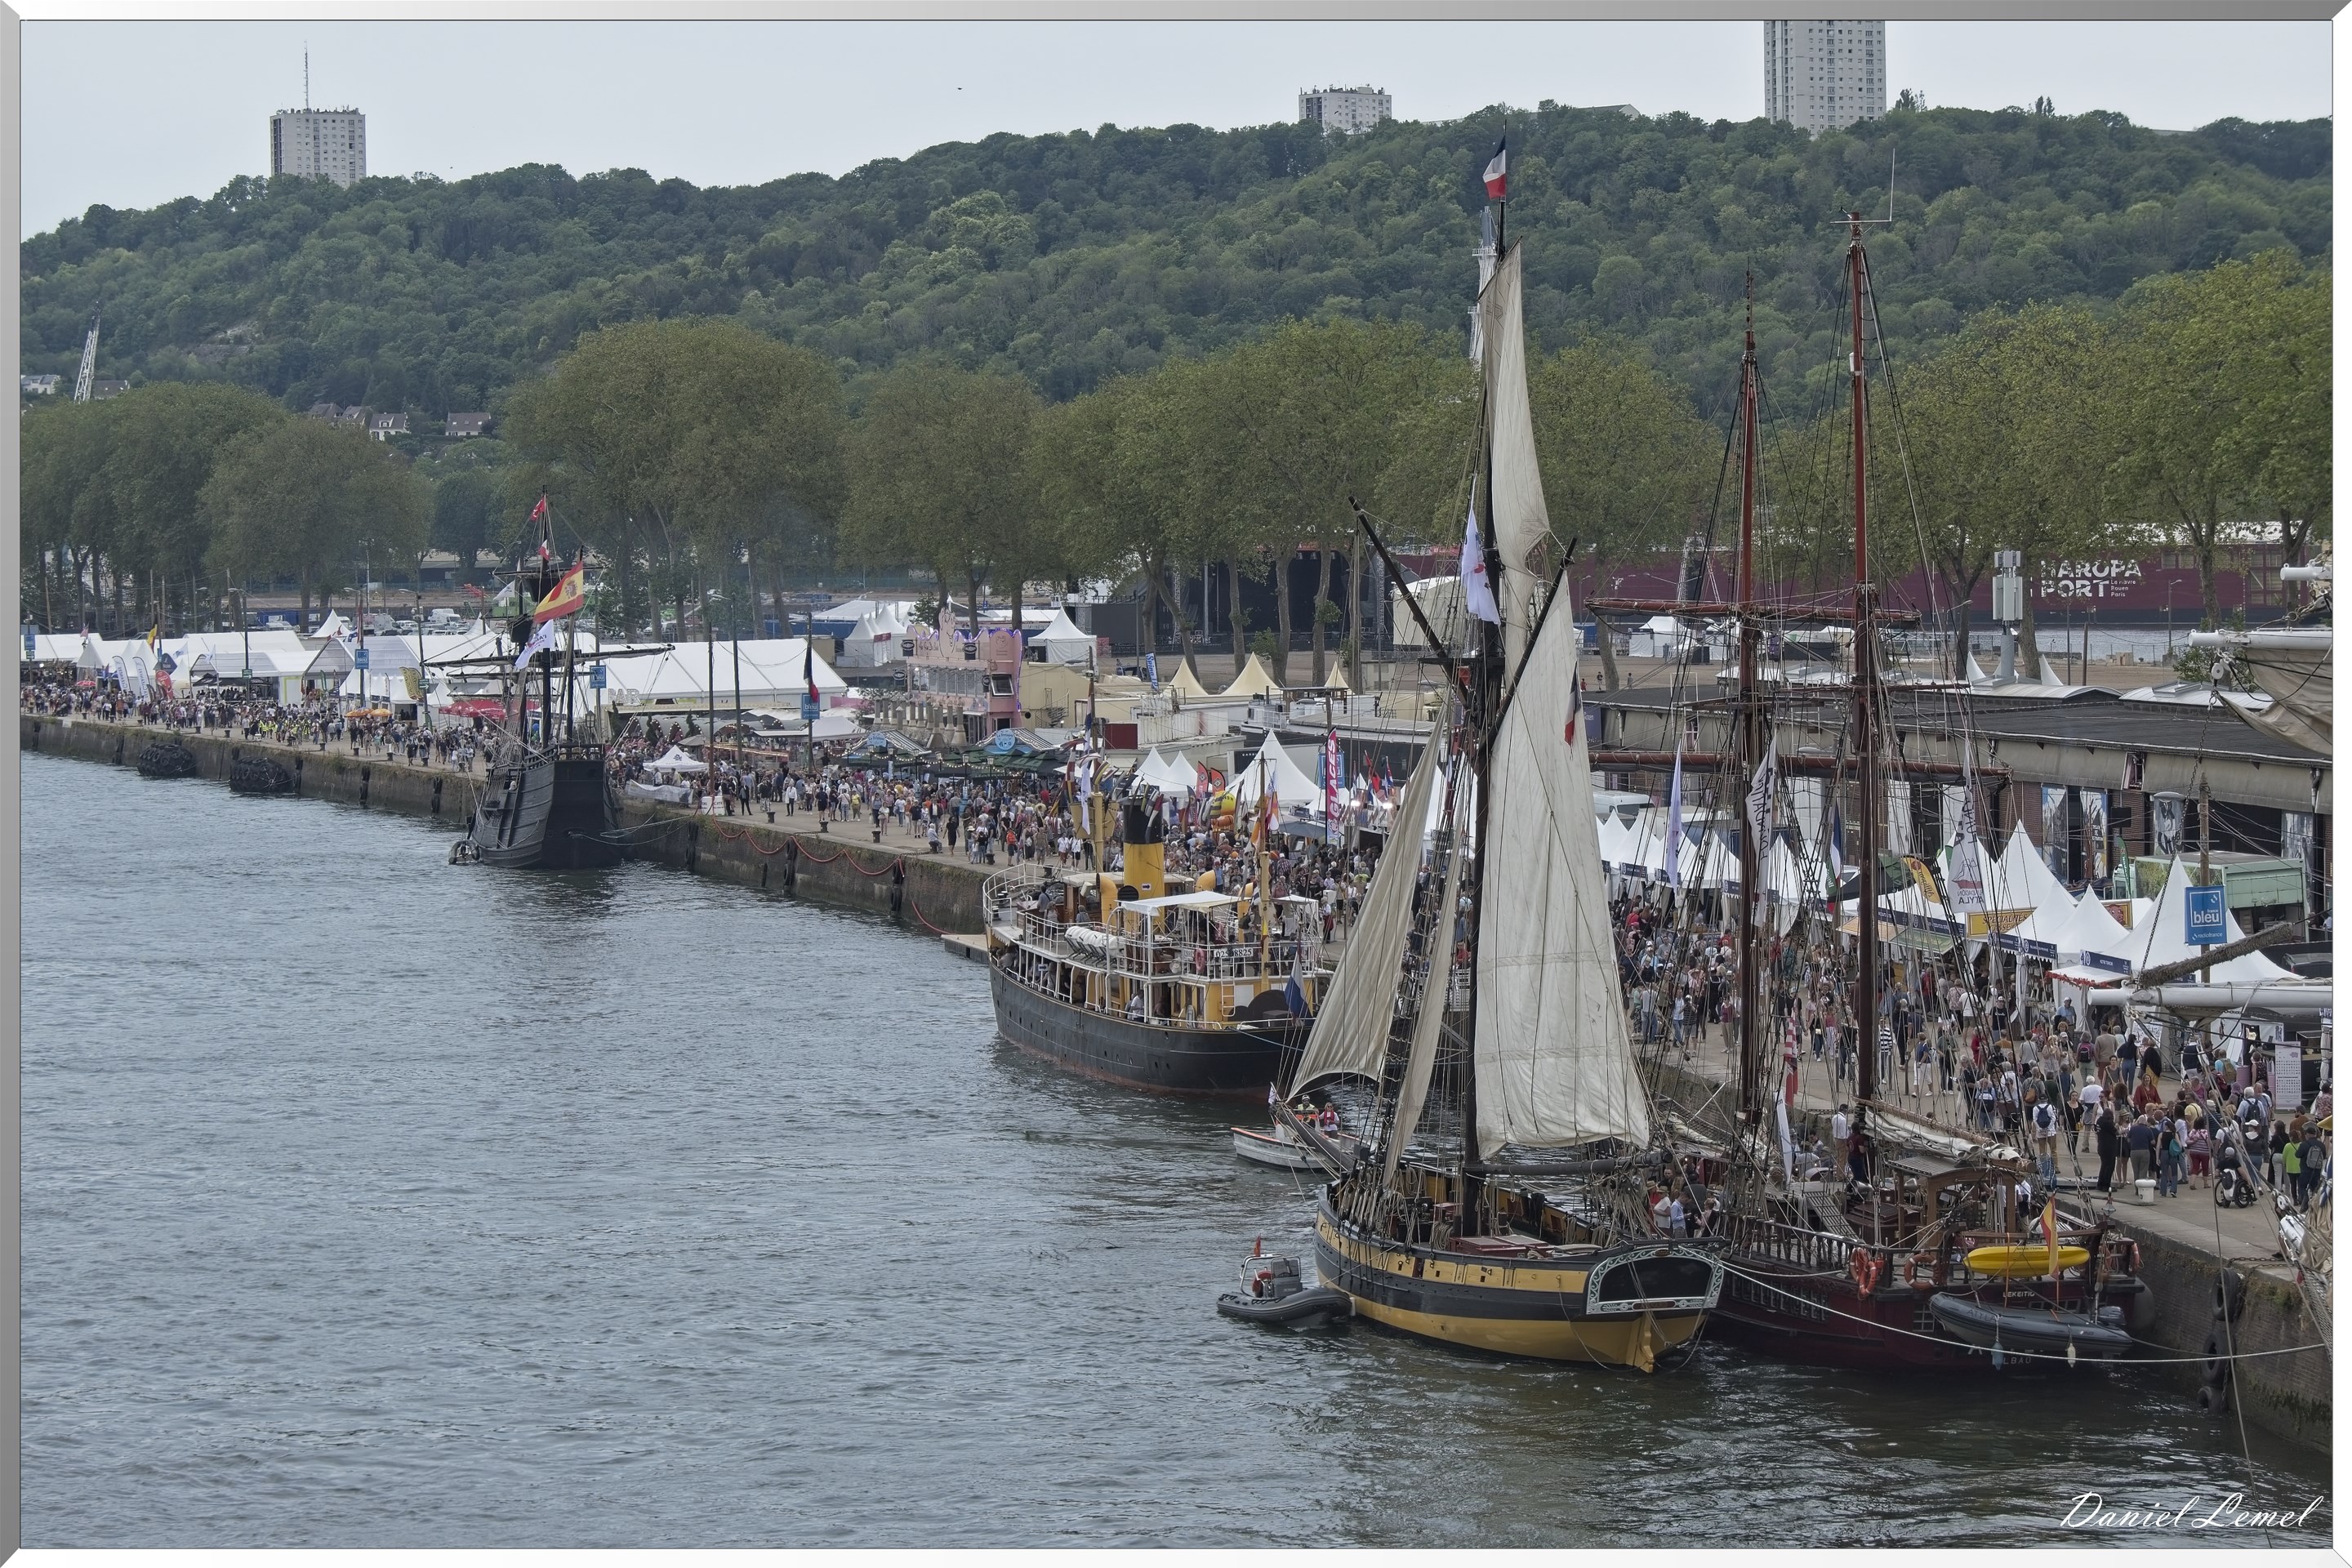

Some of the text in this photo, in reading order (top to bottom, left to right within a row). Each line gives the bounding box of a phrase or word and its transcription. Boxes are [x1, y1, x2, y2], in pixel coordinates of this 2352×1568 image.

[2041, 580, 2109, 597] PORT
[1328, 738, 1339, 818] GLACES
[2194, 911, 2220, 924] bleu
[1215, 948, 1252, 958] 0258825
[1967, 1309, 1998, 1323] ATYLA
